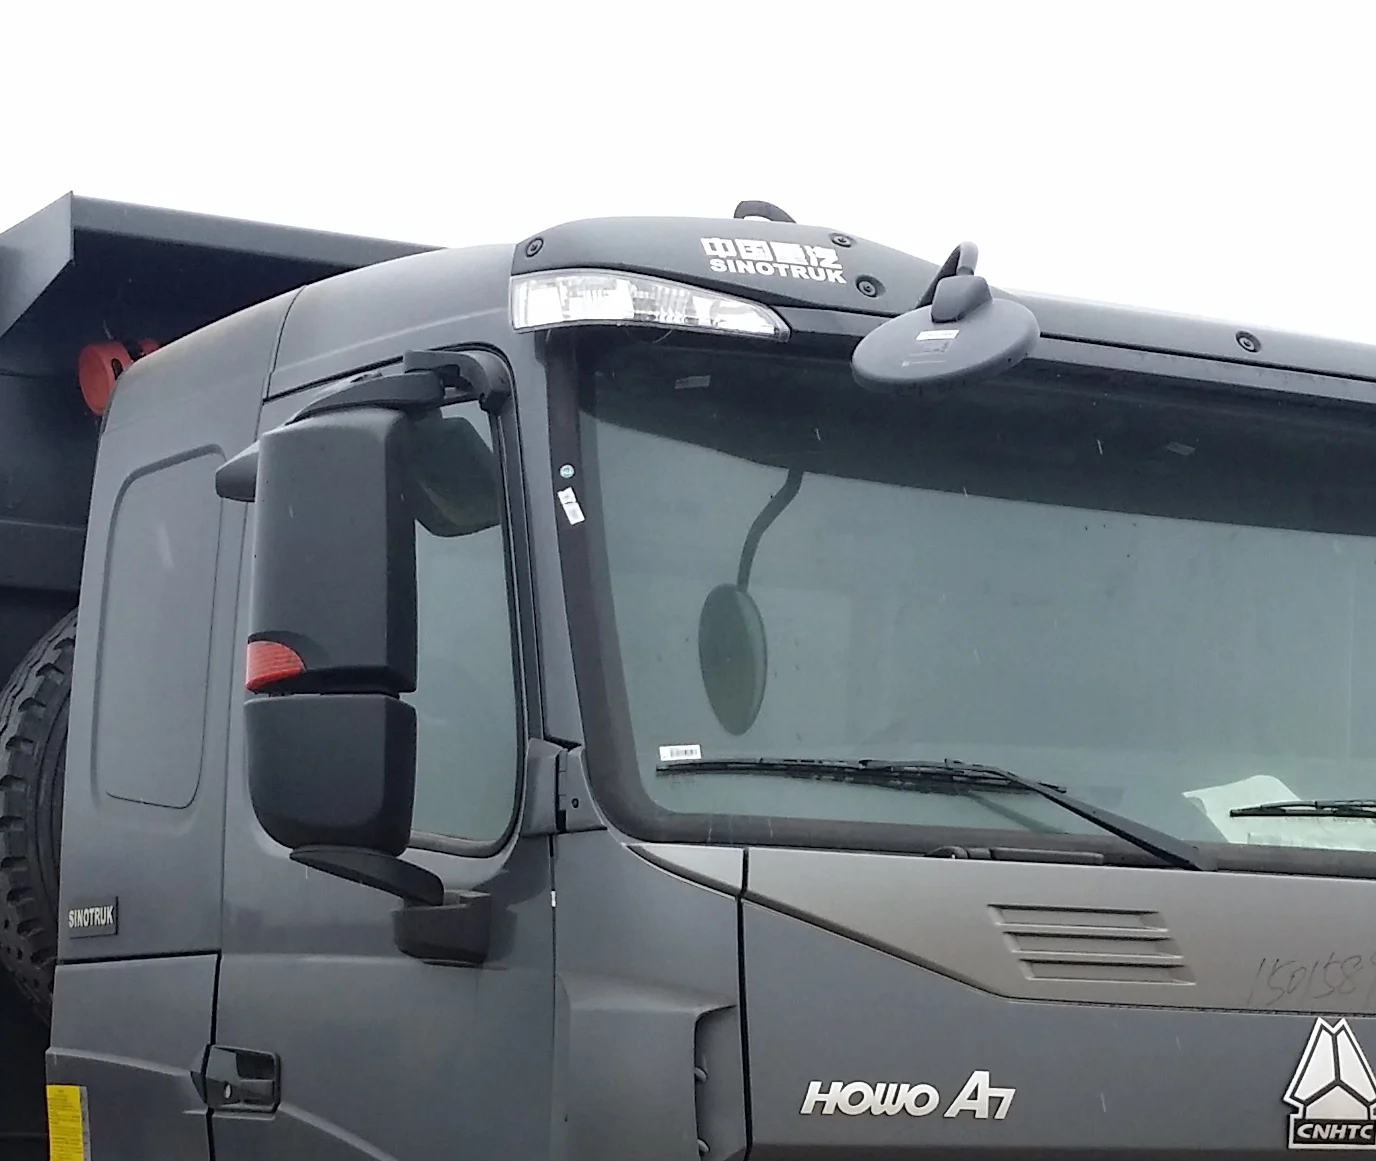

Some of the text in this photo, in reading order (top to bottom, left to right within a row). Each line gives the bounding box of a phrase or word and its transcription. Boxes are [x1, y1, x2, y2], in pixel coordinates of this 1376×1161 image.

[709, 258, 847, 284] SINOTRUK
[68, 905, 114, 928] SINOTRUK
[799, 1069, 1017, 1120] HOWO A7
[1296, 1122, 1375, 1140] CNHTC
